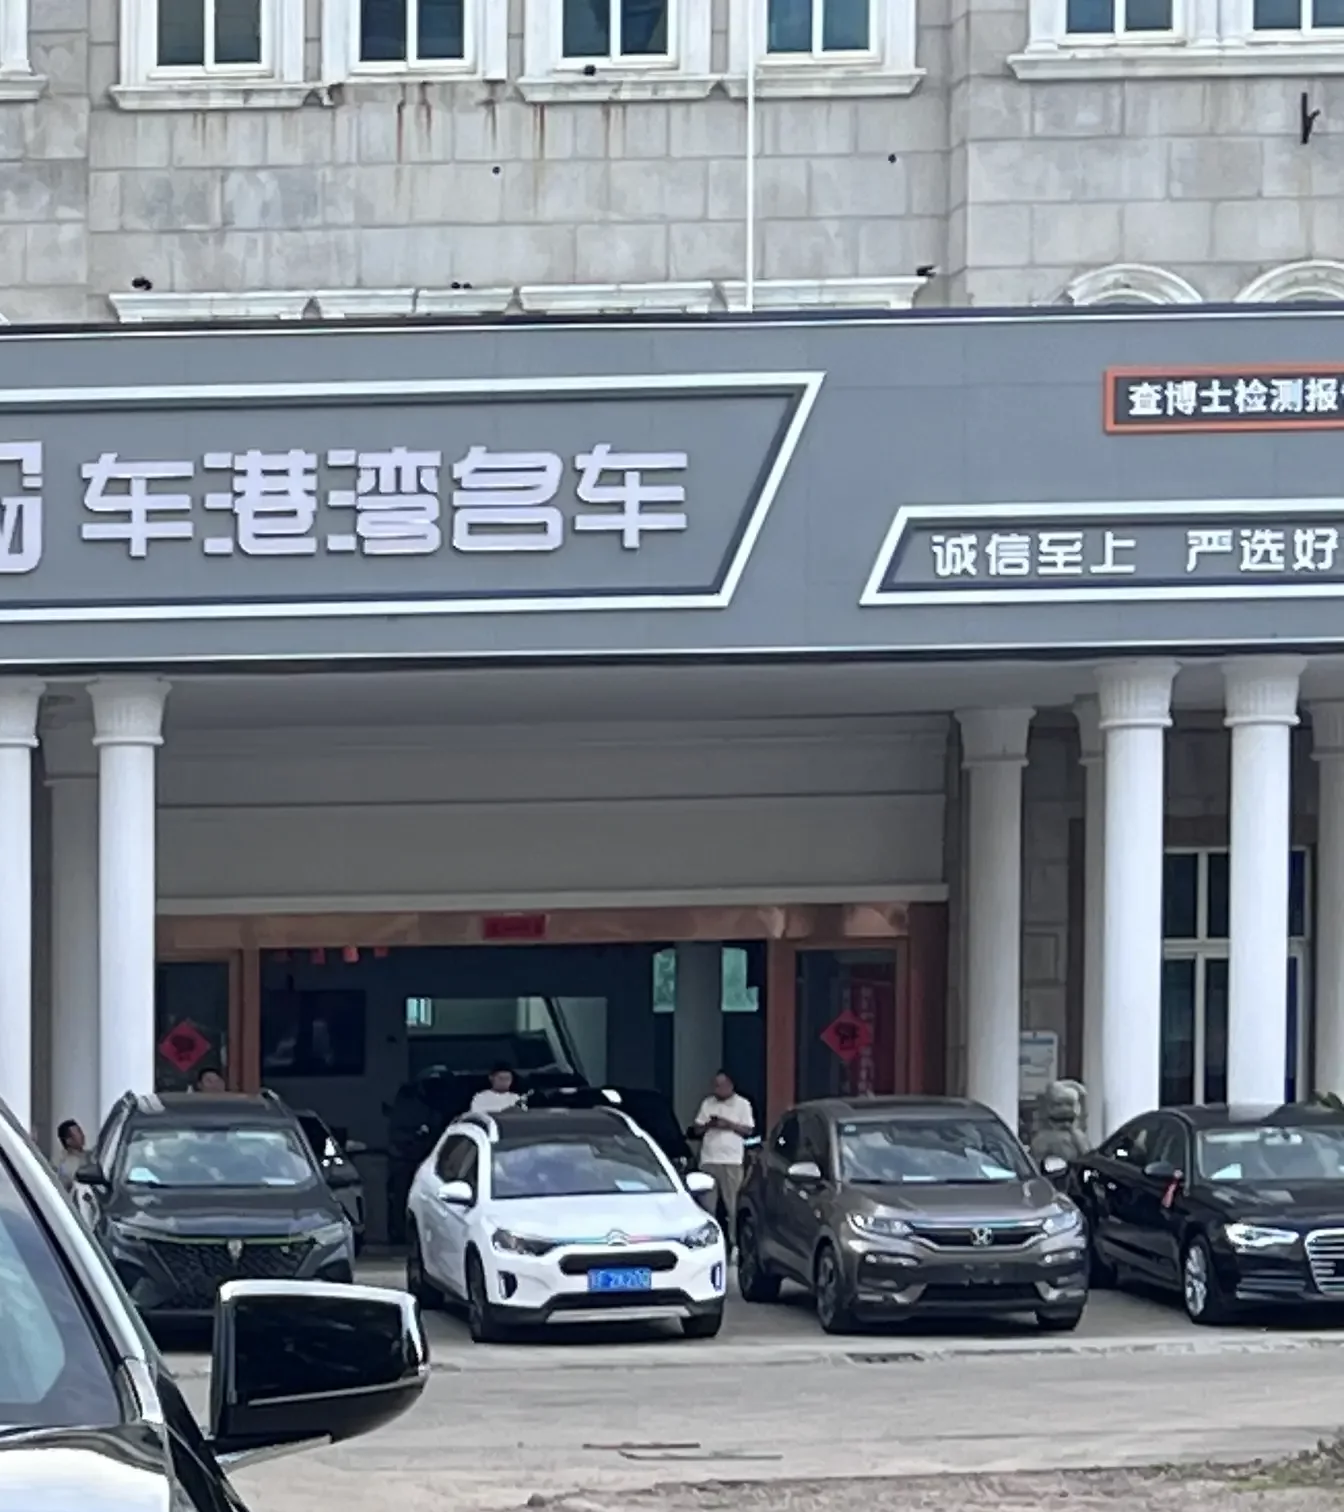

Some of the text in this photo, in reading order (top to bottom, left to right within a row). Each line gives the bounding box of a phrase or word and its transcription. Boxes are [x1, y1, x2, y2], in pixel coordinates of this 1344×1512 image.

[1128, 378, 1344, 416] 查博士检测报
[80, 445, 688, 557] 车港湾名车
[931, 528, 1339, 577] 诚信至上 严选好
